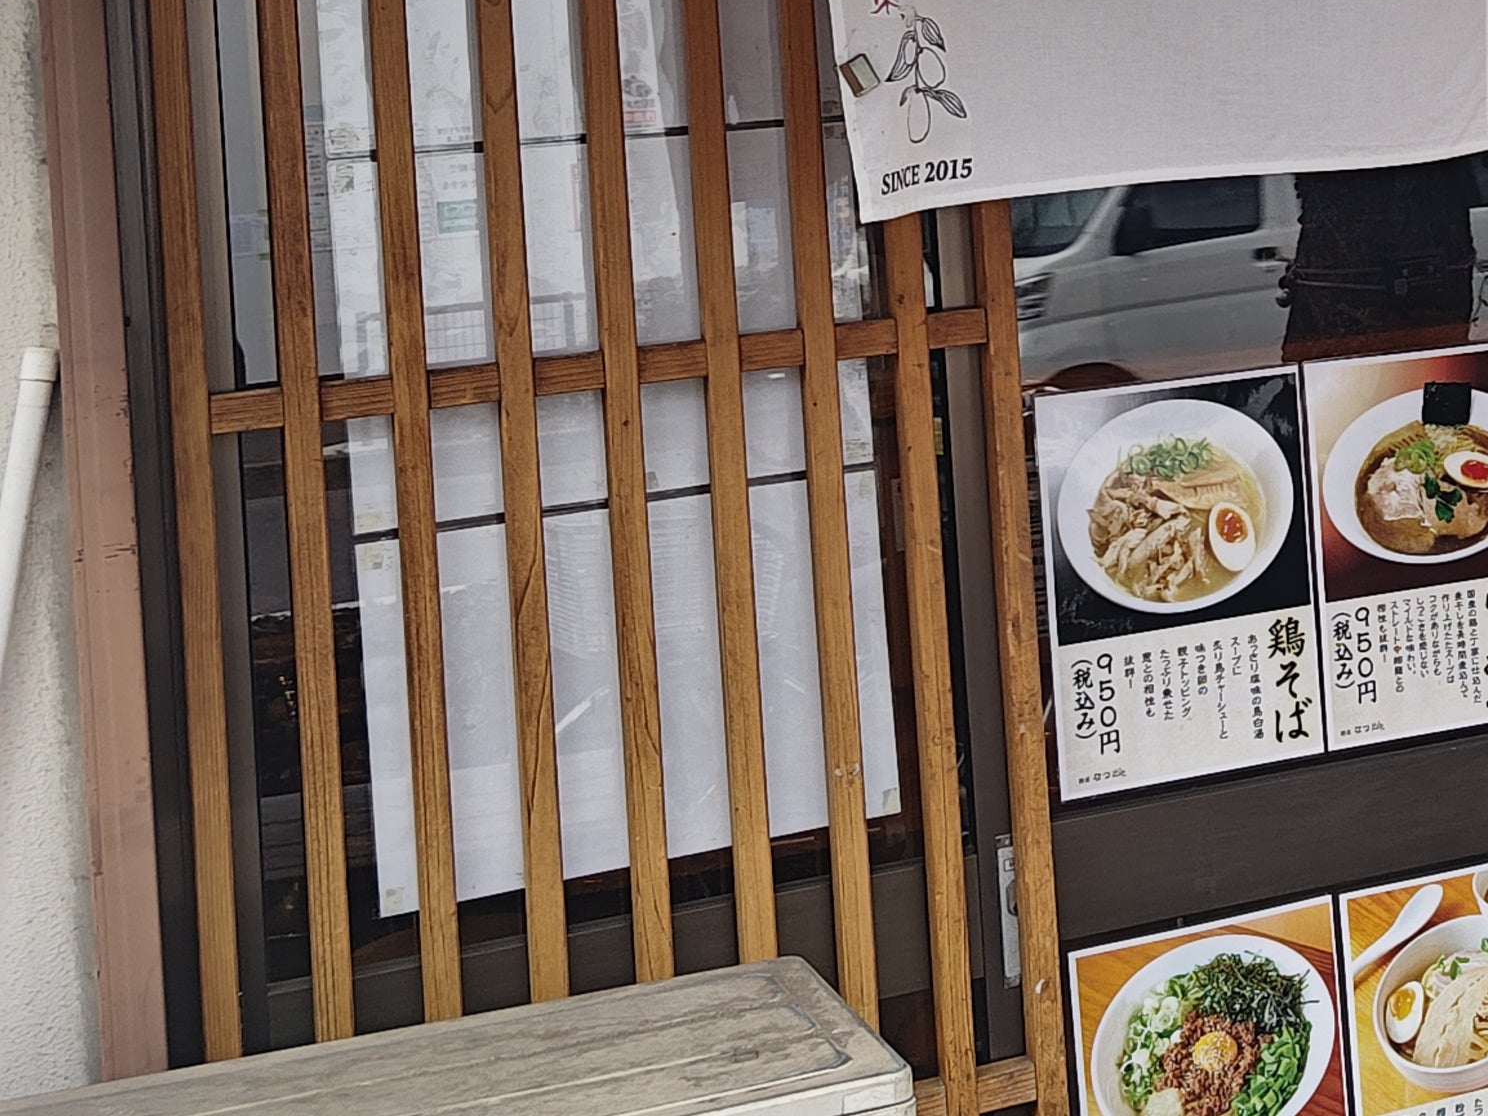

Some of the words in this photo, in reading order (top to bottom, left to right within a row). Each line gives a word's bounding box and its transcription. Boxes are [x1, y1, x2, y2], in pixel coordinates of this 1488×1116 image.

[881, 164, 920, 196] SINCE
[924, 158, 973, 184] 2015
[1097, 653, 1121, 755] 950円
[1231, 636, 1243, 677] スープに
[1267, 616, 1313, 744] 鶏そば
[1355, 606, 1377, 704] 950円
